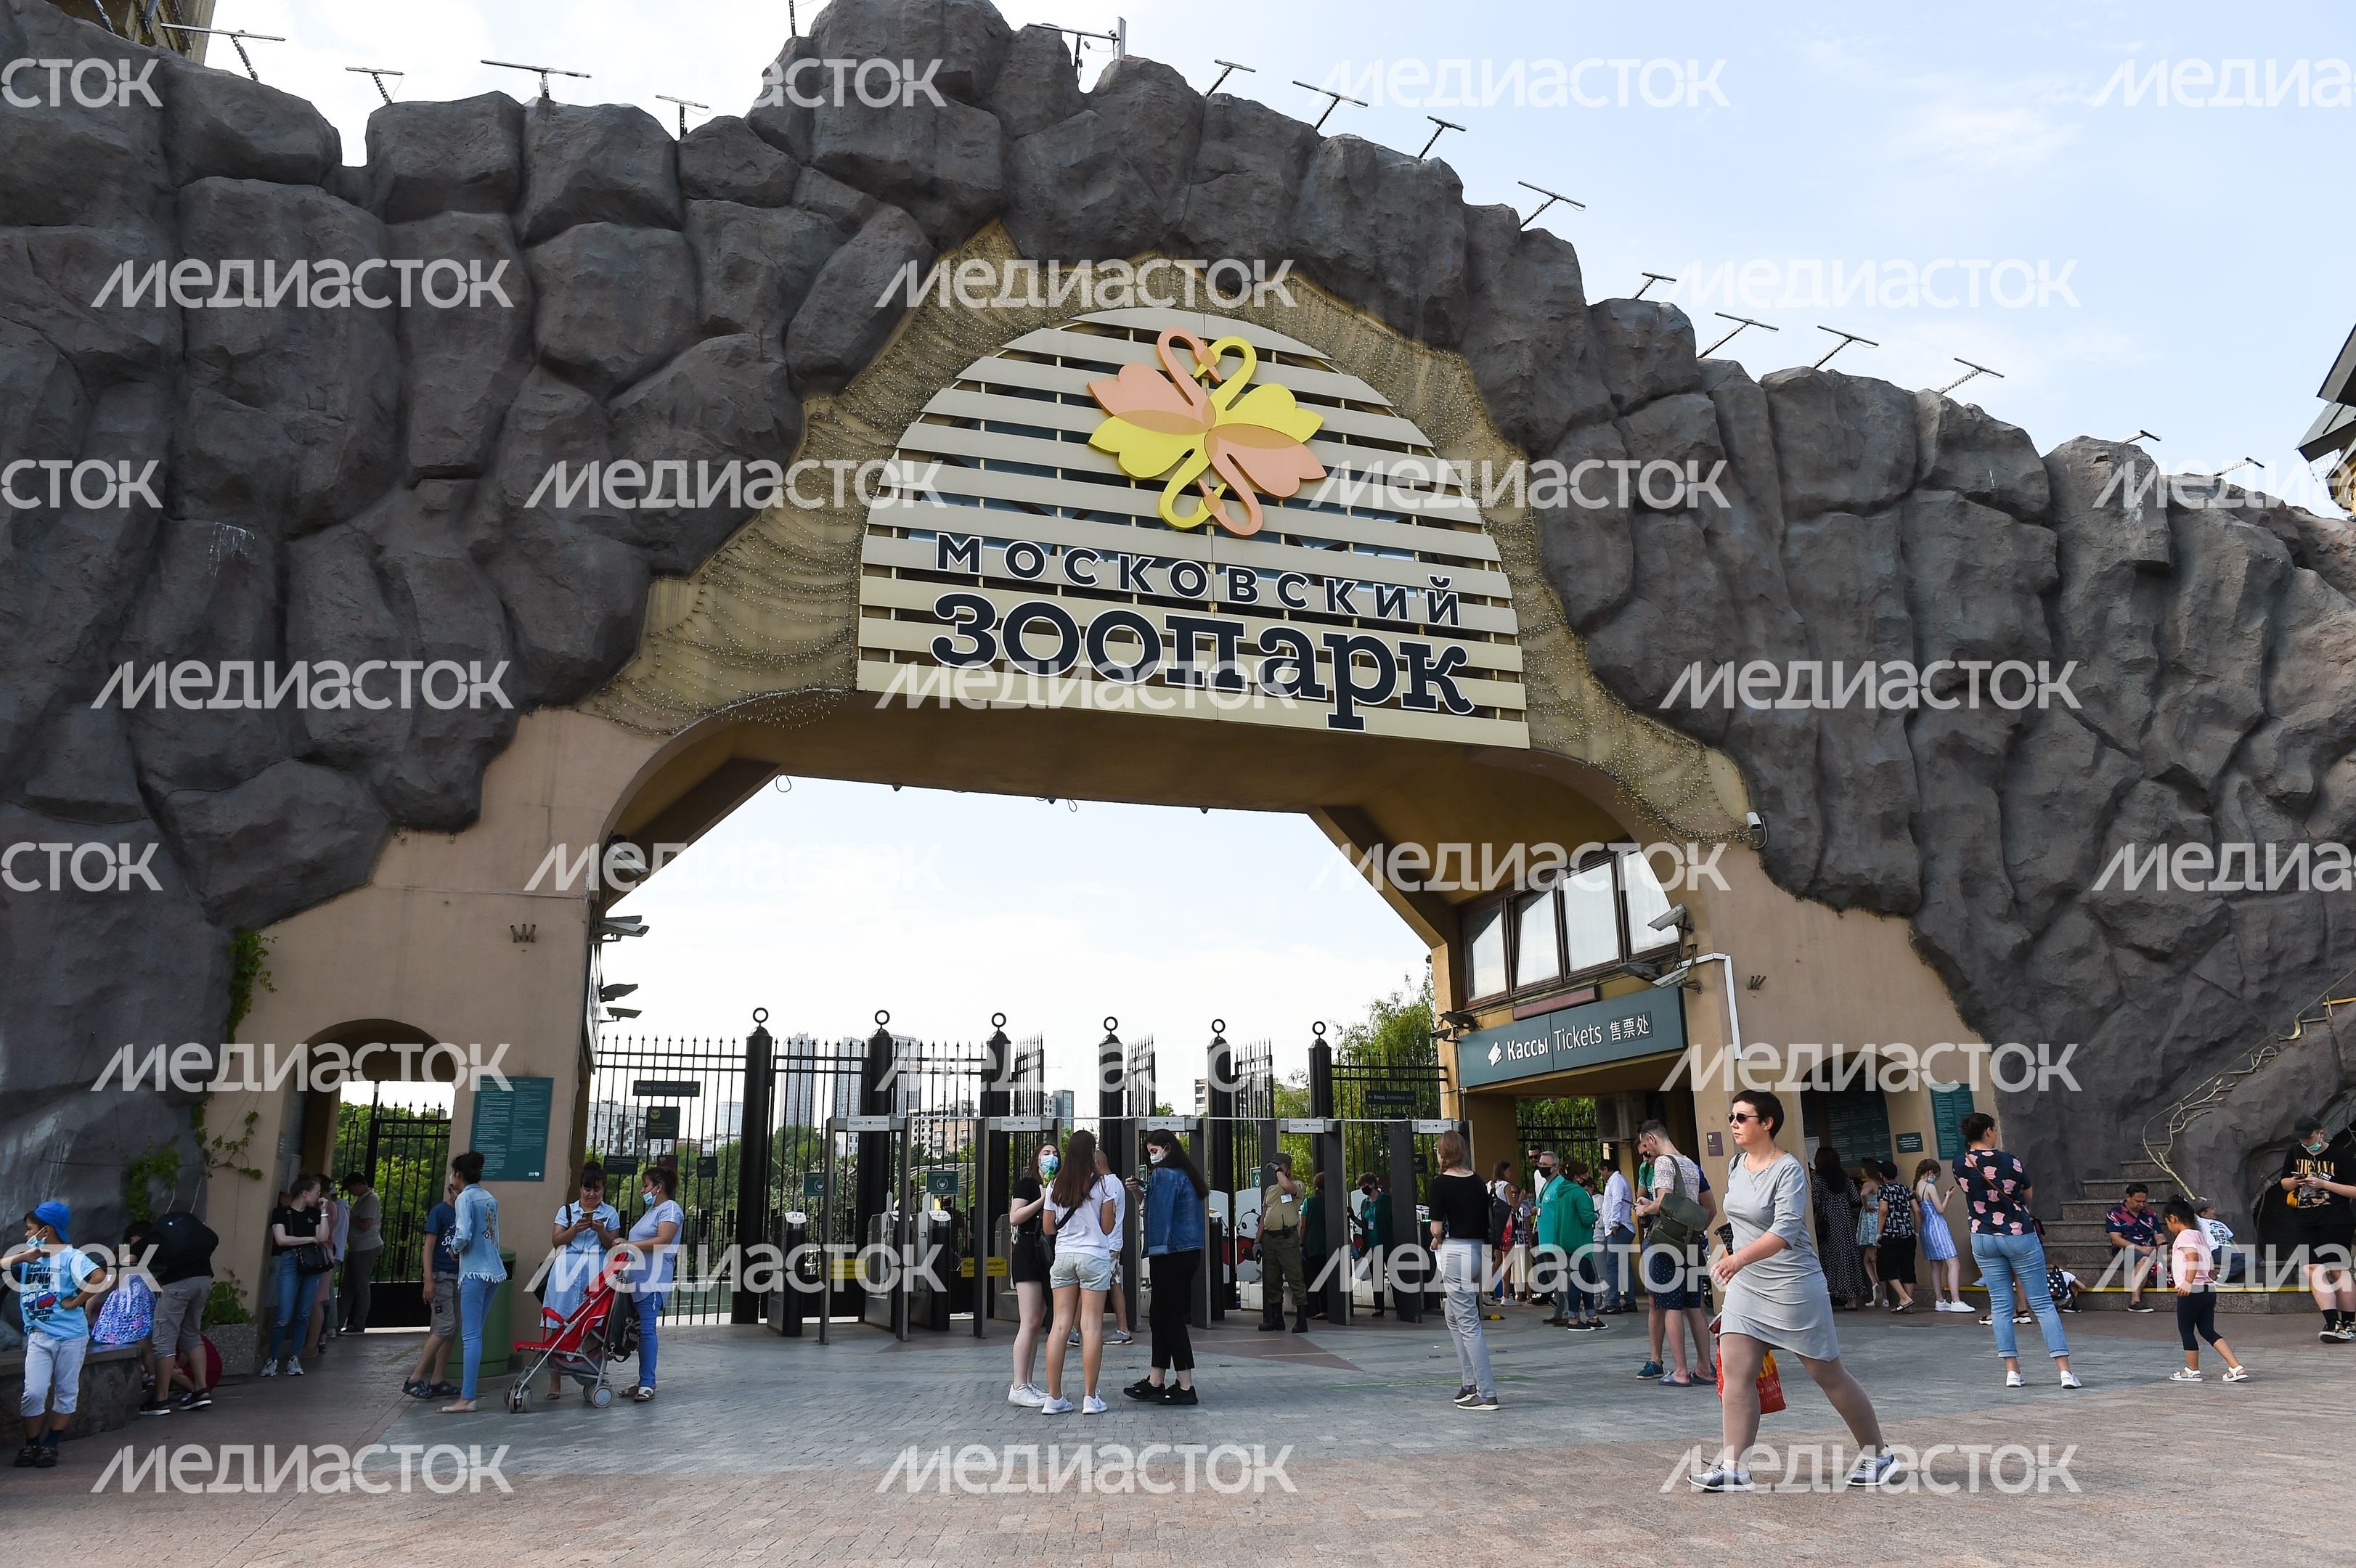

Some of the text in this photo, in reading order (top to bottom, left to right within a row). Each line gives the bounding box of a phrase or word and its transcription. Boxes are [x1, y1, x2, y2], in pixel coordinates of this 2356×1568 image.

[1507, 1014, 1650, 1062] Кассы Tickets 售票处
